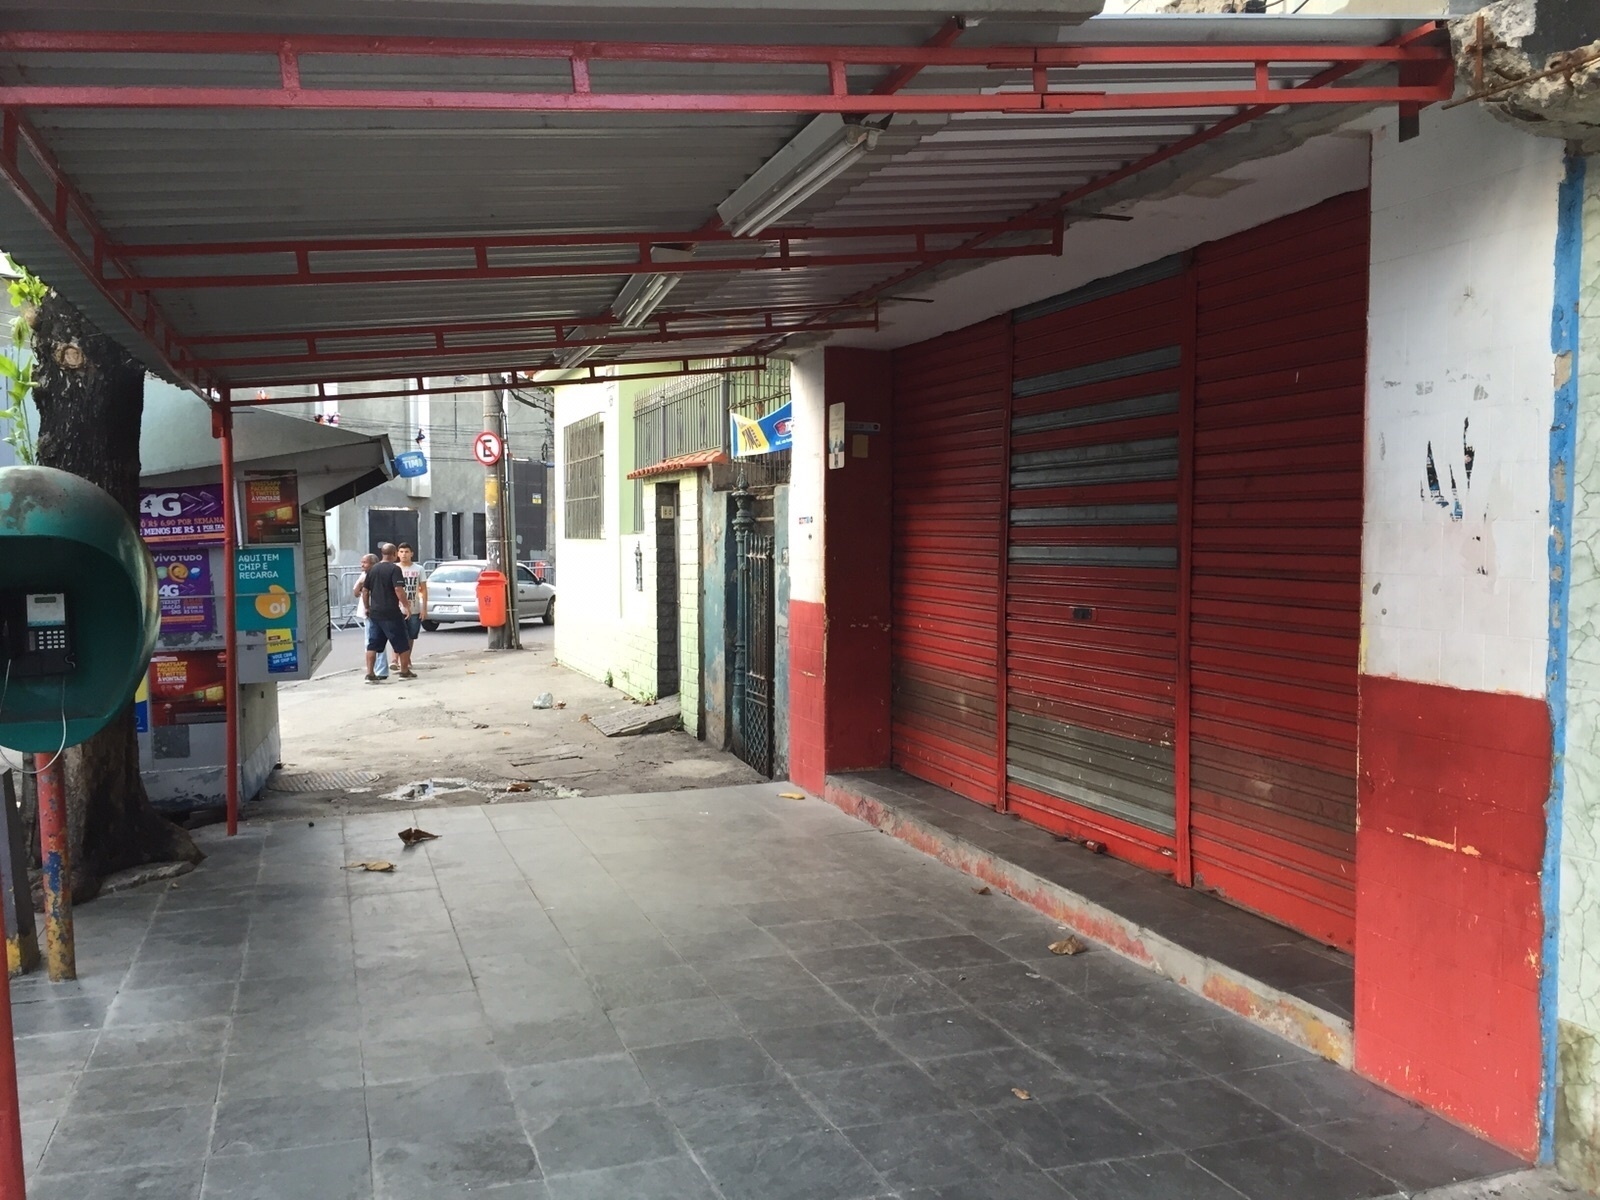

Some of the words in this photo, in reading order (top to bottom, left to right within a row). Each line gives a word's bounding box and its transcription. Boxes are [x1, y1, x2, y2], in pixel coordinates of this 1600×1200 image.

[482, 439, 492, 458] E
[402, 459, 420, 470] TIM
[140, 493, 182, 517] 4G
[144, 527, 170, 535] MENOS
[240, 571, 279, 579] RECARGA
[405, 577, 417, 585] ATE
[159, 584, 179, 597] 4G
[270, 597, 286, 614] oi
